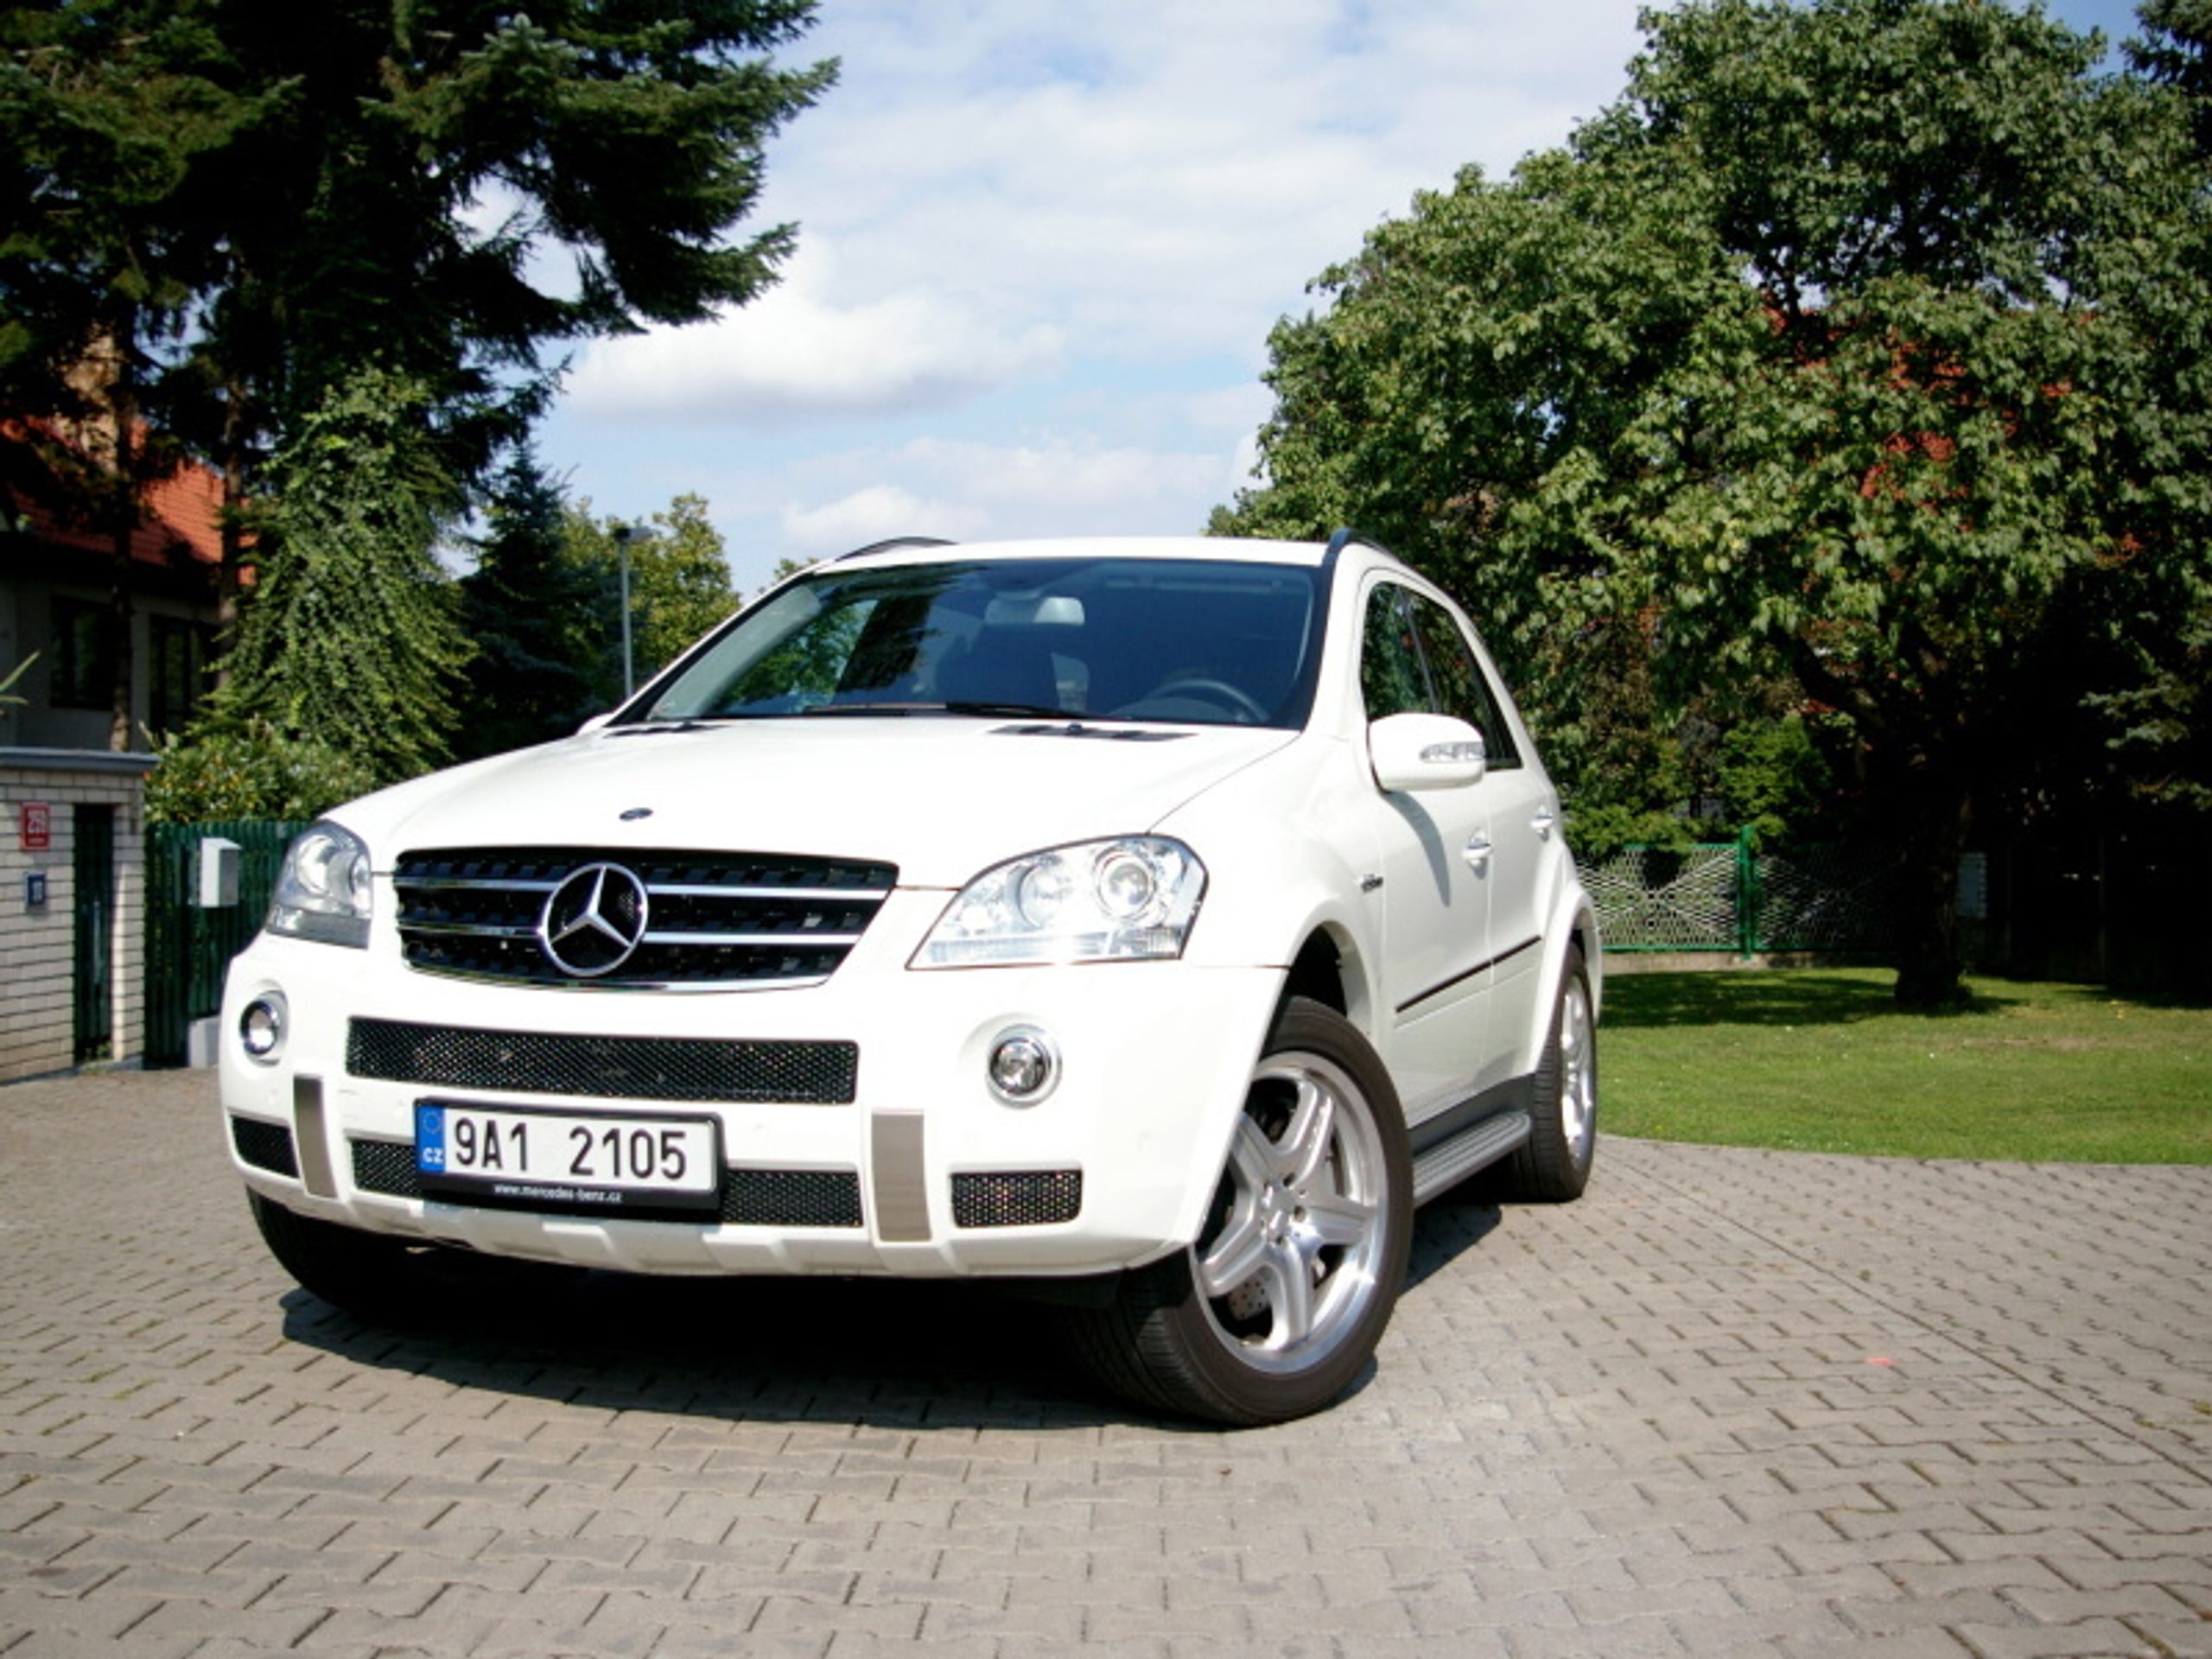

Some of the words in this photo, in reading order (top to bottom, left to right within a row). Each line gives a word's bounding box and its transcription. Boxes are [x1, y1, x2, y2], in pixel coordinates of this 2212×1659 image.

[423, 1147, 443, 1163] CZ
[455, 1118, 527, 1171] 9A1
[569, 1126, 686, 1179] 2105
[494, 1184, 622, 1203] www.mercedes-benz.cz
